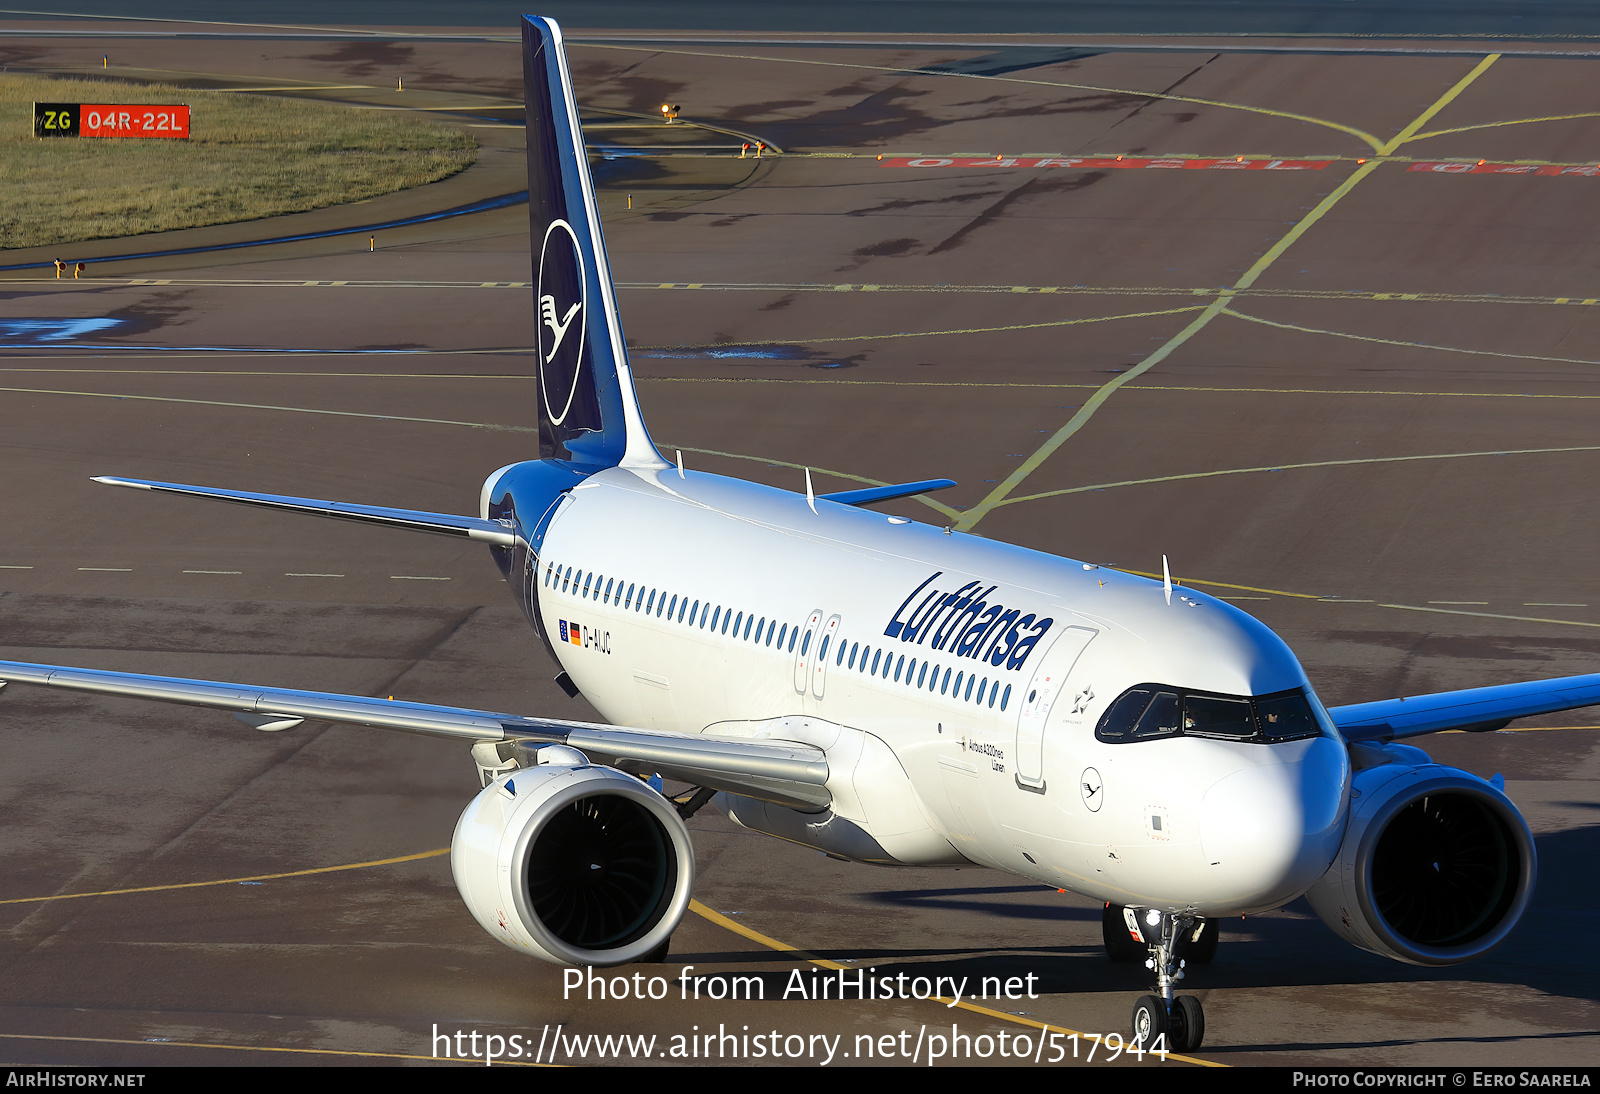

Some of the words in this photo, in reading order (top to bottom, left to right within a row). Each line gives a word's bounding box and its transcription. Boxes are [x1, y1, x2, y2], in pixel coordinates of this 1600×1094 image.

[44, 111, 71, 130] ZG
[87, 111, 183, 131] 04R-22L
[883, 571, 1054, 671] Lufthansa
[583, 625, 611, 655] D-AIJC
[969, 738, 983, 754] Airbus
[983, 743, 1004, 760] A320neo
